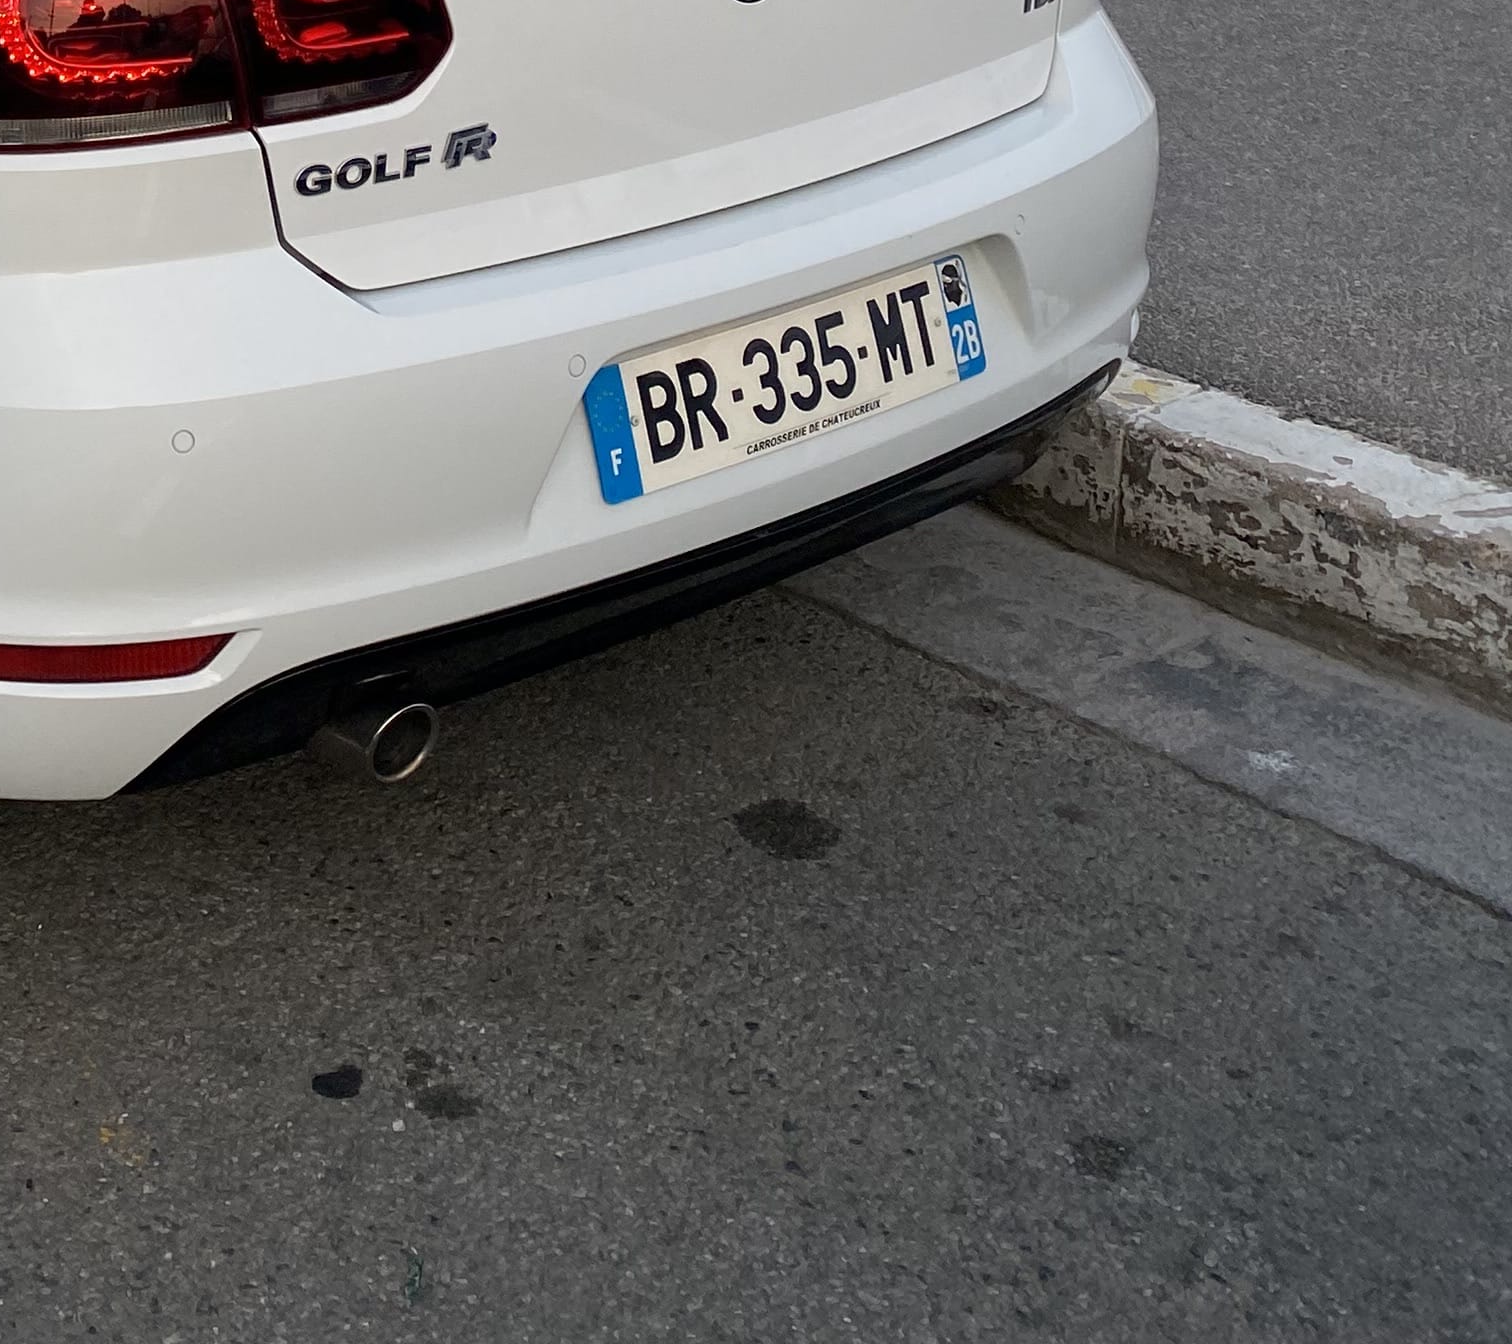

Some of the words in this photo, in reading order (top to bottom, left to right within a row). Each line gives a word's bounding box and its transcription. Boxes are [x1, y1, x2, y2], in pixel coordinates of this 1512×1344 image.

[295, 144, 432, 197] GOLF
[440, 122, 497, 170] R
[952, 319, 981, 364] 2B
[746, 426, 807, 455] CARROSSERIE
[809, 421, 820, 434] DE
[610, 449, 623, 476] F
